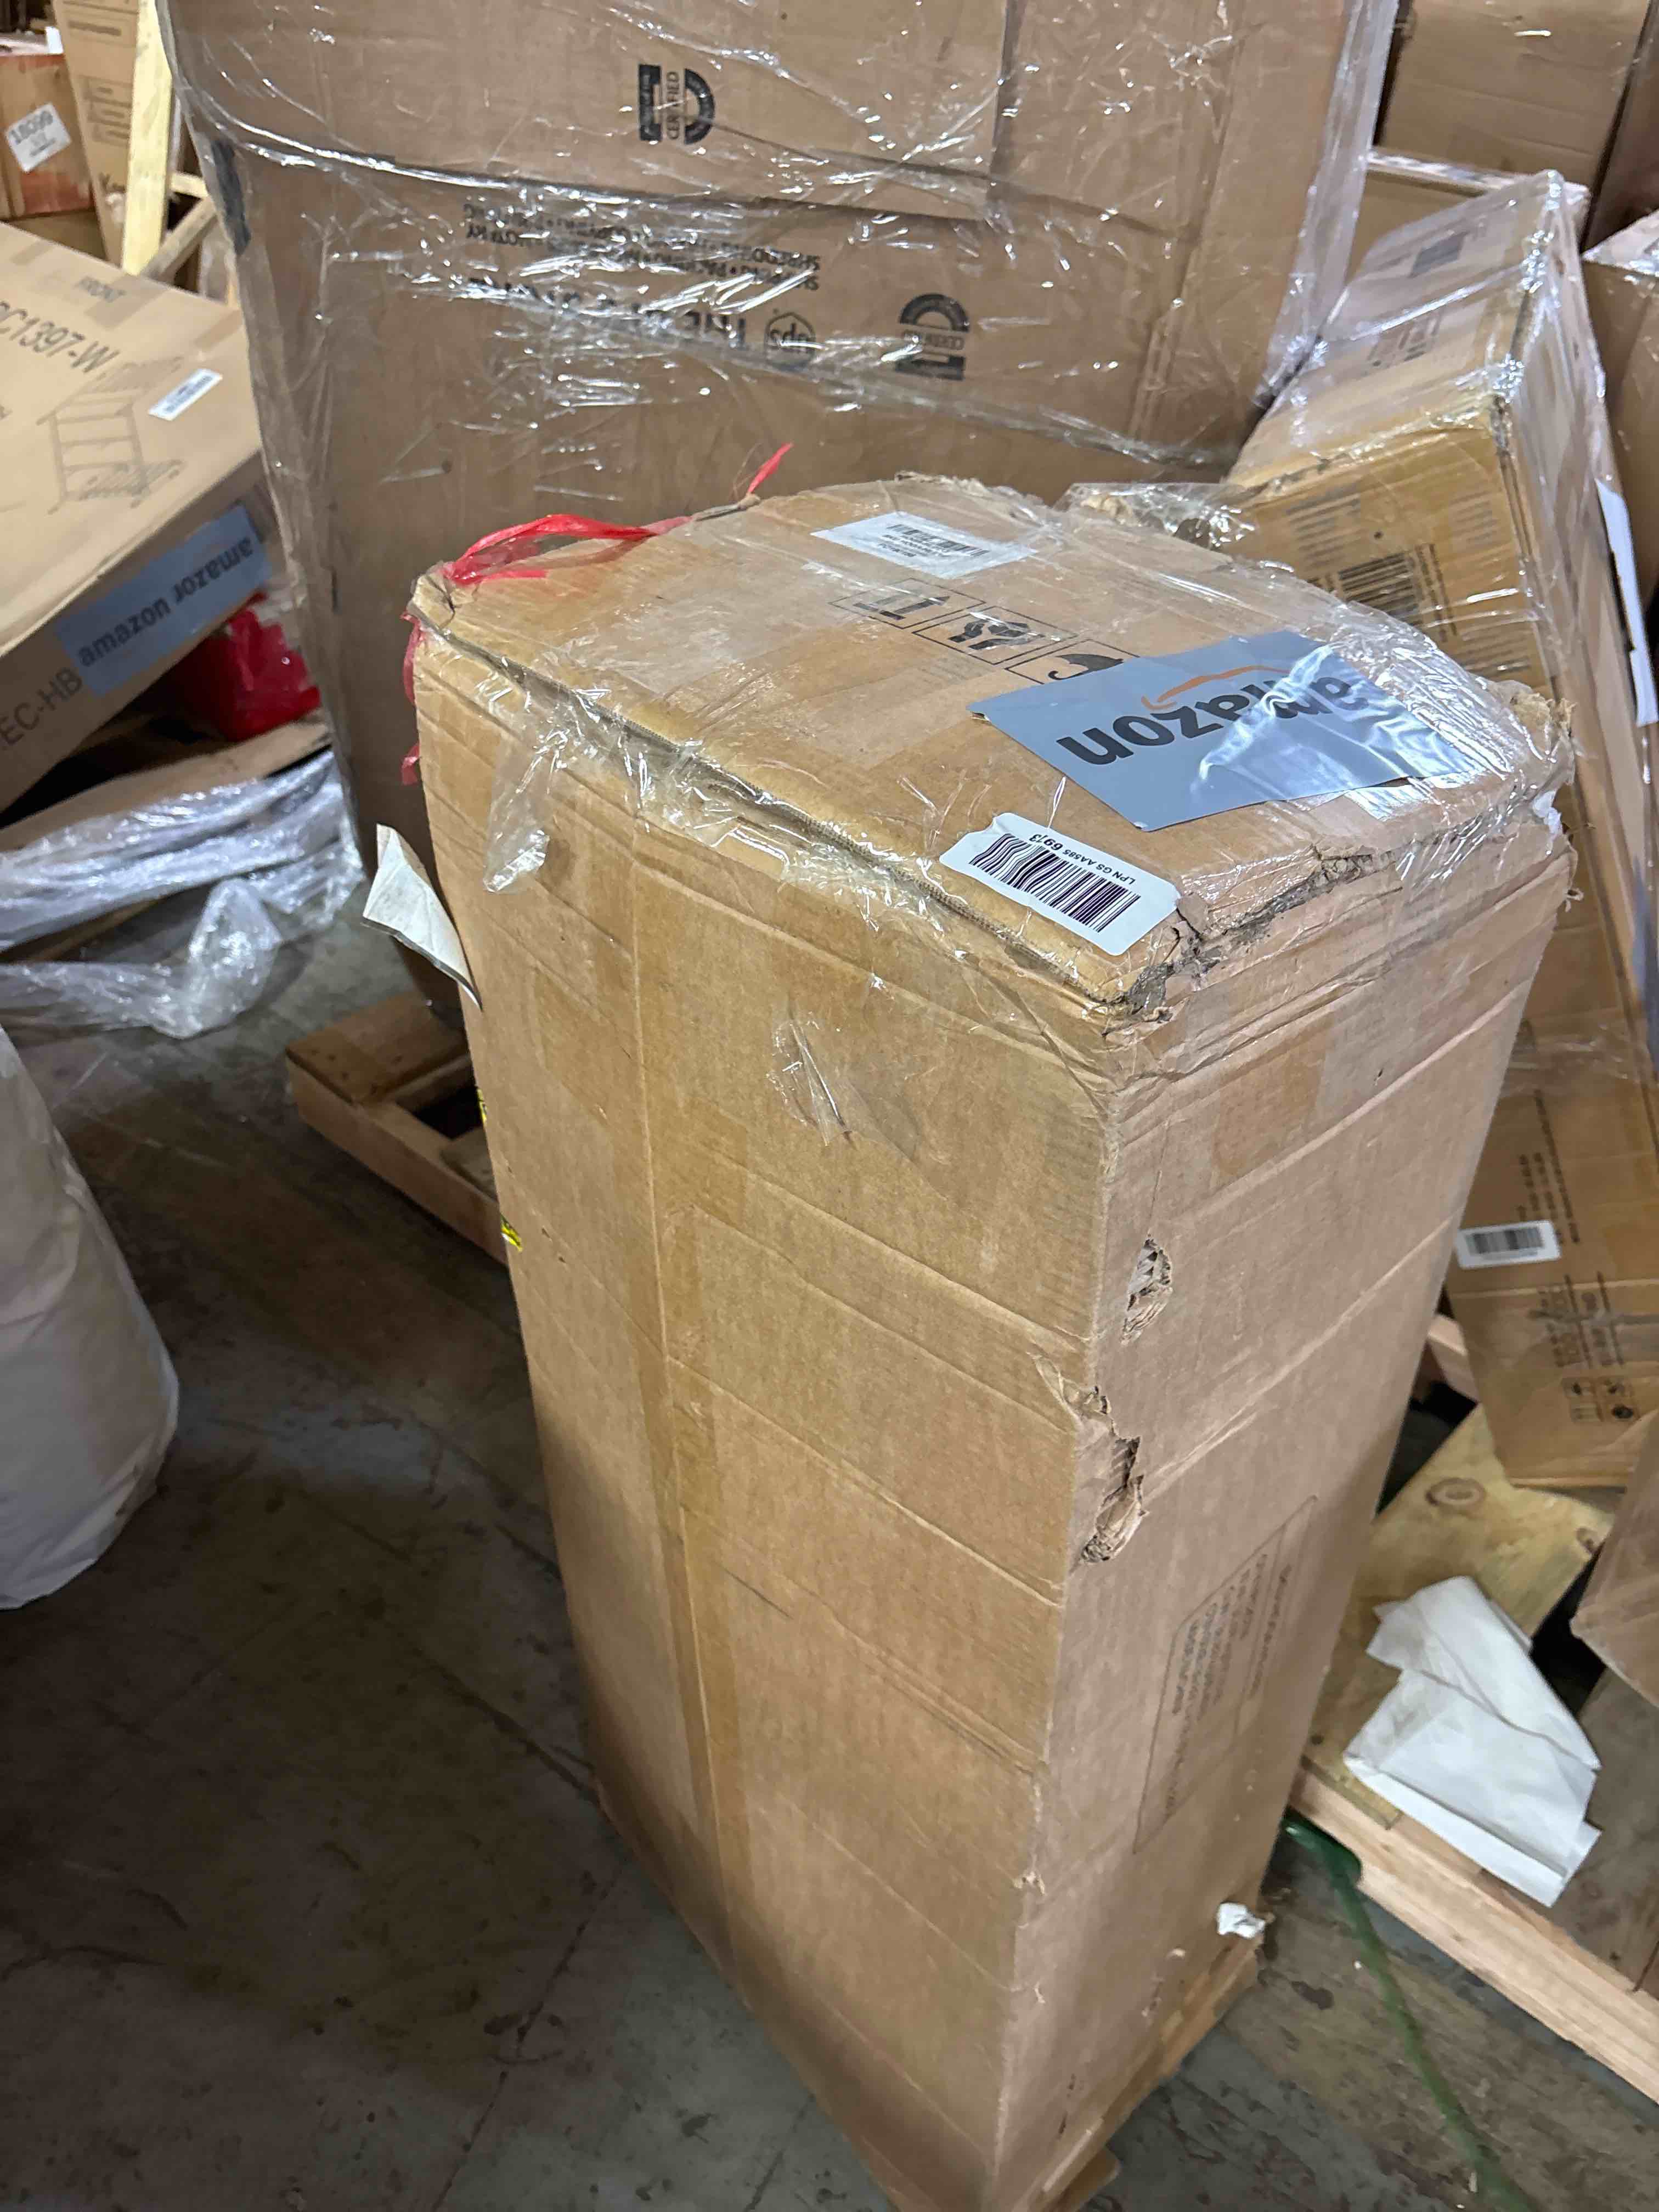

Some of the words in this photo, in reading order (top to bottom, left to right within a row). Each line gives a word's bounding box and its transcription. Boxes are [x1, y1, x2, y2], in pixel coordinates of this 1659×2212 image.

[78, 599, 172, 667] amazon
[1062, 849, 1097, 865] AA585
[1096, 864, 1112, 874] GS
[1112, 871, 1136, 884] LPN
